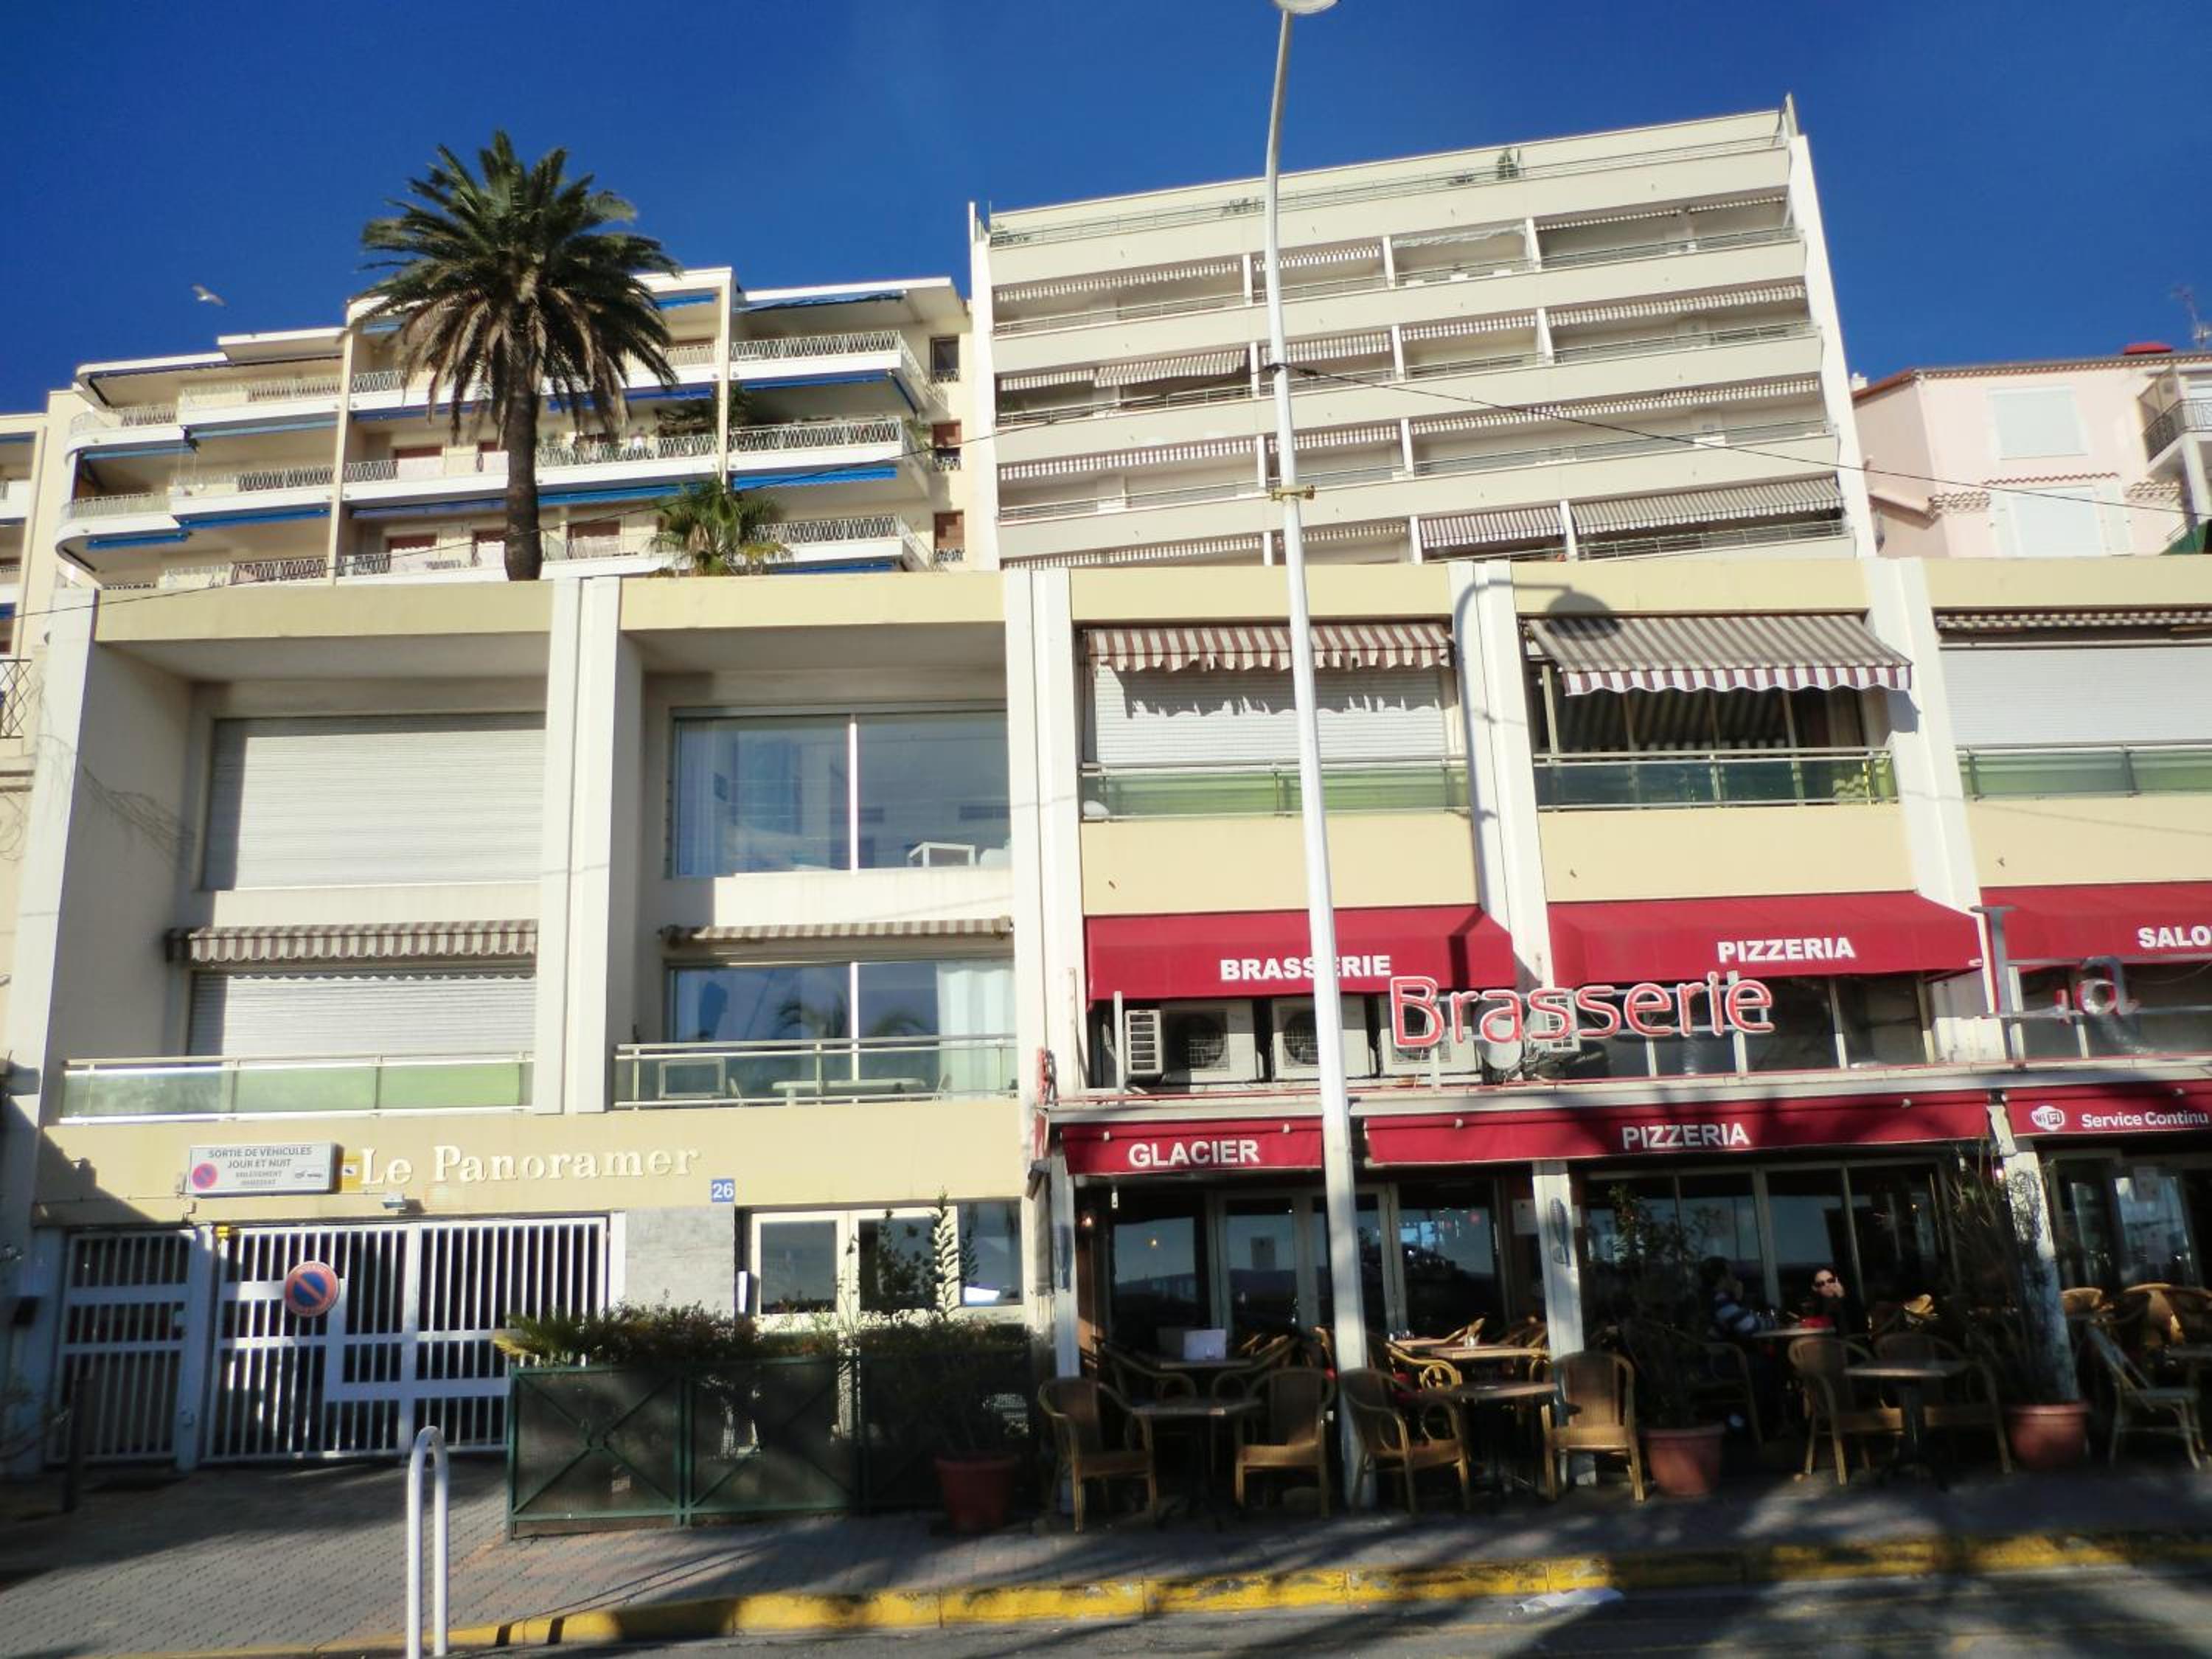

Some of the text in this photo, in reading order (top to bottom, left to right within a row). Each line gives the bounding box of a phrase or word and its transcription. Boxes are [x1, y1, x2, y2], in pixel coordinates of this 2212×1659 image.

[2138, 925, 2212, 948] SALO
[1717, 937, 1857, 964] PIZZERIA
[1220, 955, 1392, 981] BRASSRIE
[1390, 971, 1775, 1047] Brasserie
[2081, 1110, 2209, 1128] Service Continu
[1622, 1122, 1751, 1150] PIZZERIA
[209, 1150, 242, 1158] SORTIE
[244, 1149, 257, 1157] DE
[254, 1160, 265, 1168] ET
[268, 1158, 292, 1167] NUIT
[360, 1145, 701, 1186] Le Panoramer
[1128, 1139, 1261, 1168] GLACIER
[713, 1183, 734, 1198] 26
